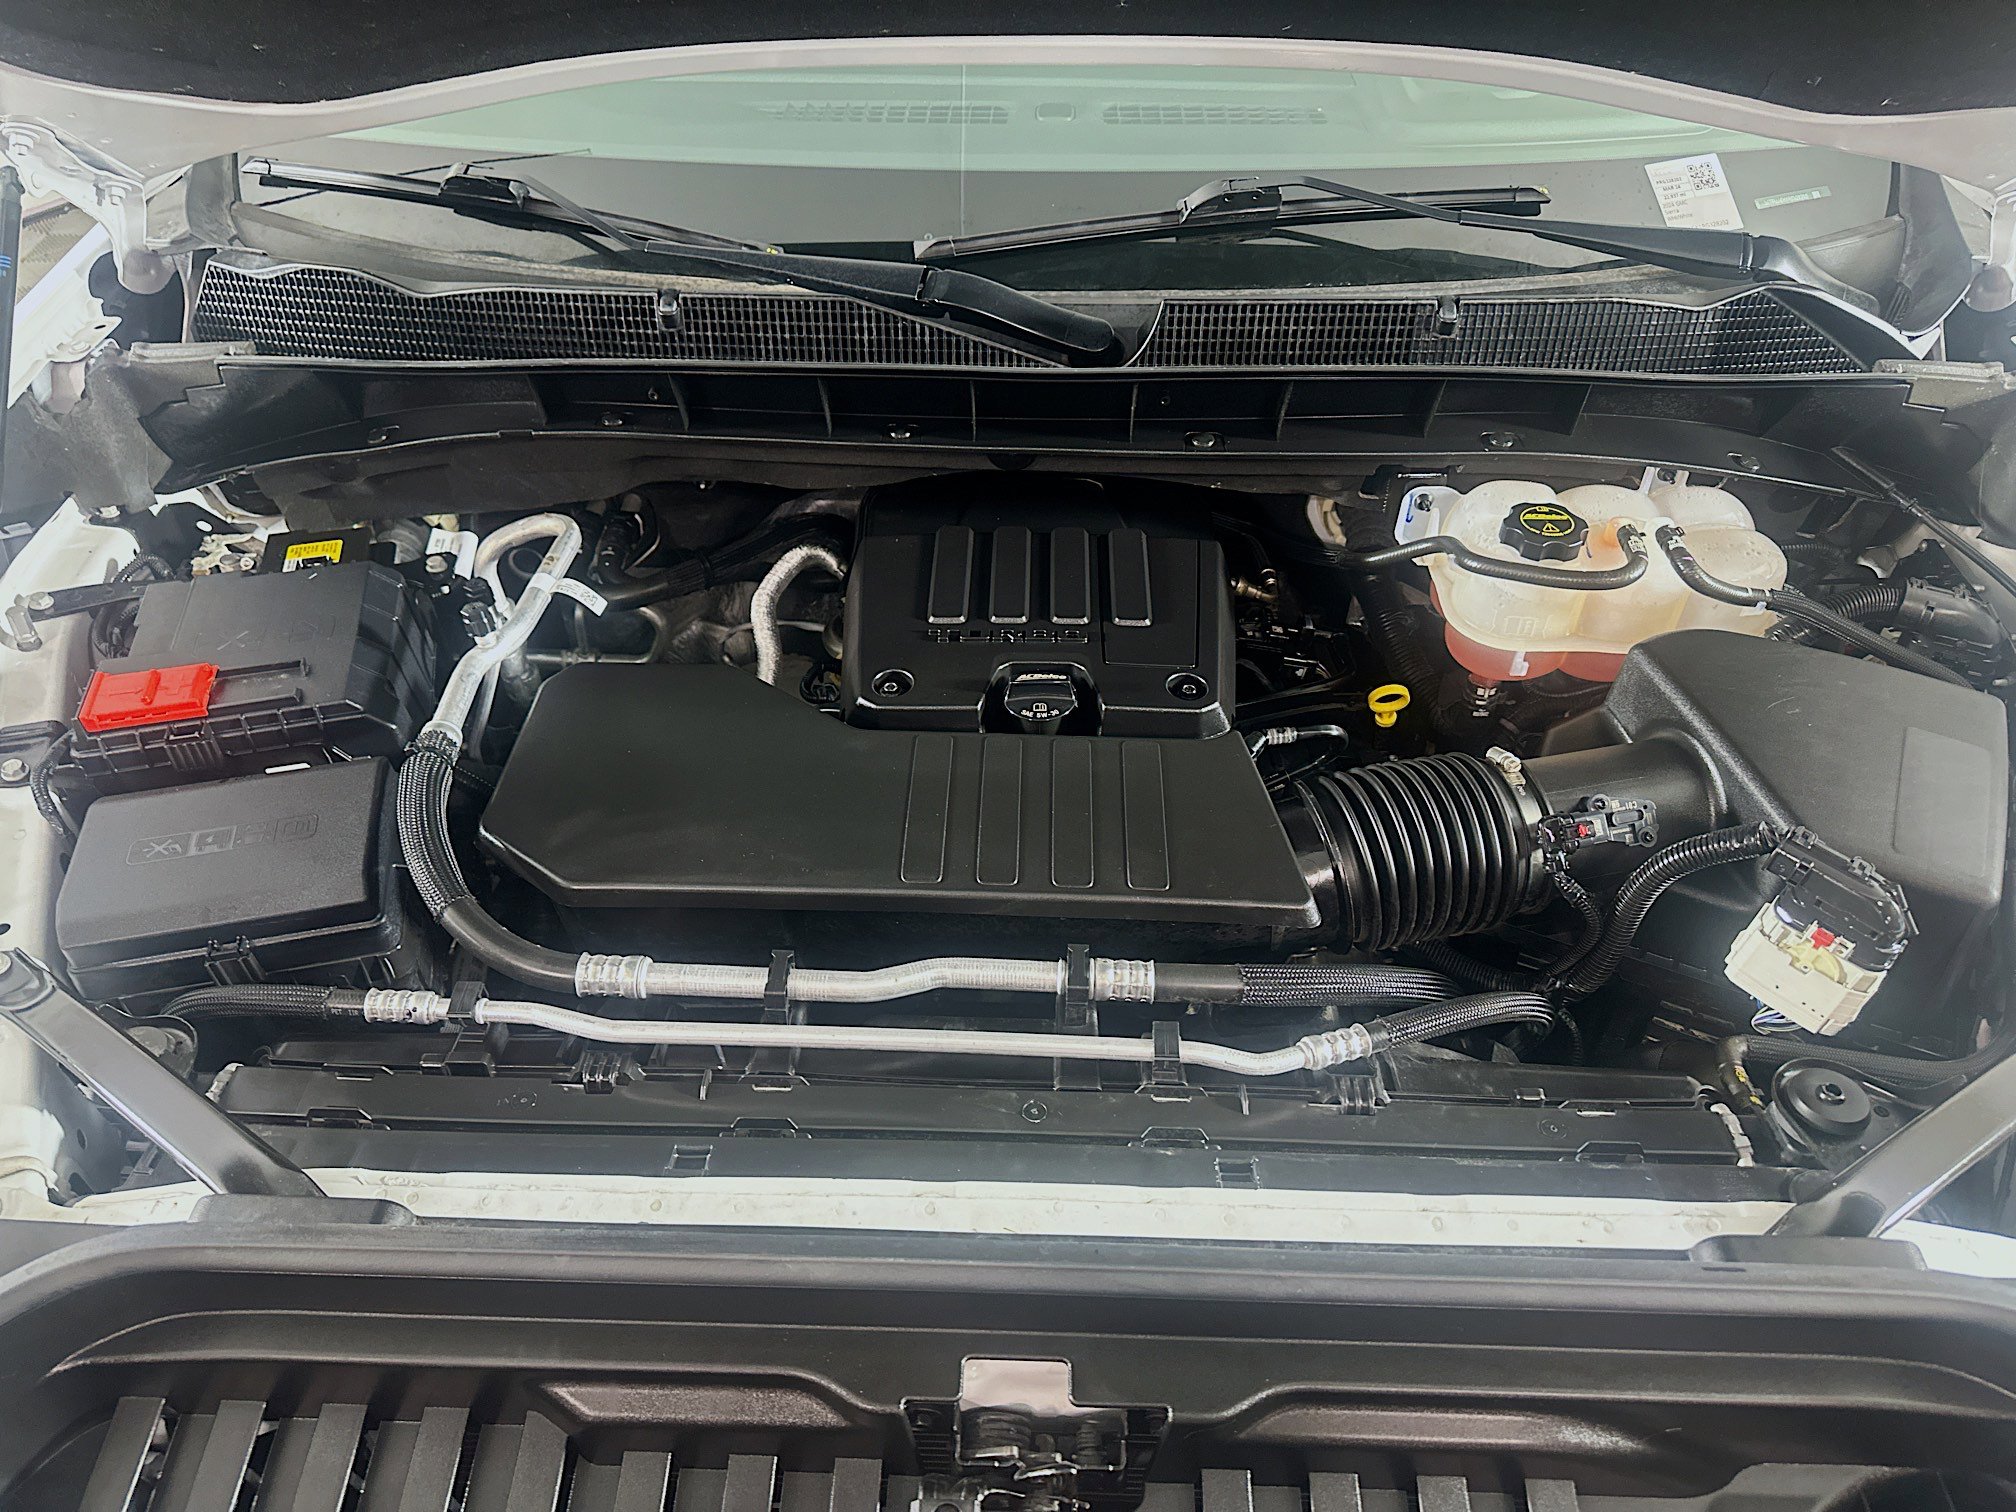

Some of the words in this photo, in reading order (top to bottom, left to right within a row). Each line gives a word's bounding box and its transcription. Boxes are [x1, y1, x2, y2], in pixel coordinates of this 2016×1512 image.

[1014, 673, 1067, 682] ACDelco
[1020, 709, 1034, 718] SAE
[1036, 708, 1060, 718] 5W-30
